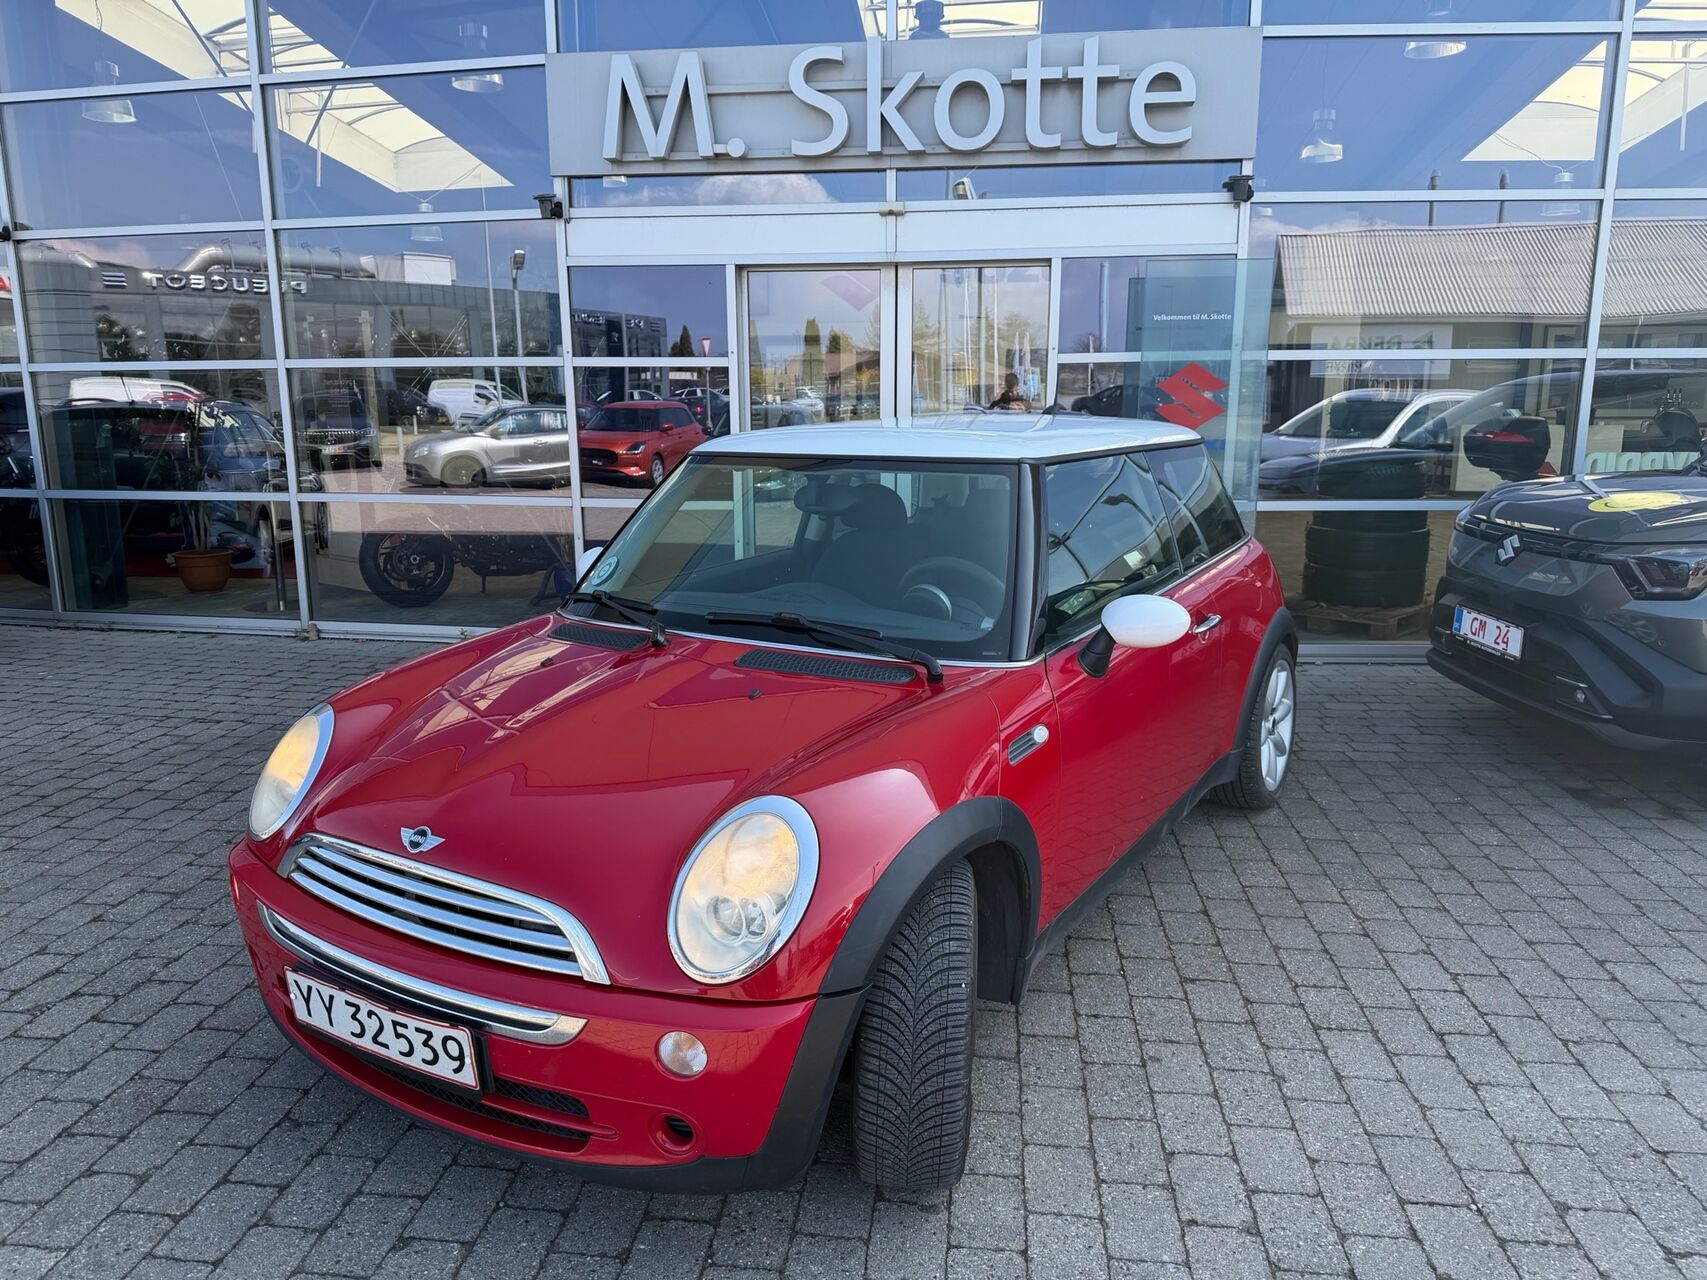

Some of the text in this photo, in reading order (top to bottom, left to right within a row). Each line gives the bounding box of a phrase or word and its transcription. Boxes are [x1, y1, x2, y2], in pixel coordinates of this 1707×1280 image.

[602, 34, 1197, 164] M. Skotte
[1200, 313, 1210, 321] M.
[1470, 616, 1487, 639] GM
[1494, 625, 1510, 648] 24
[409, 834, 426, 844] MINI
[294, 979, 467, 1074] YY 32539
